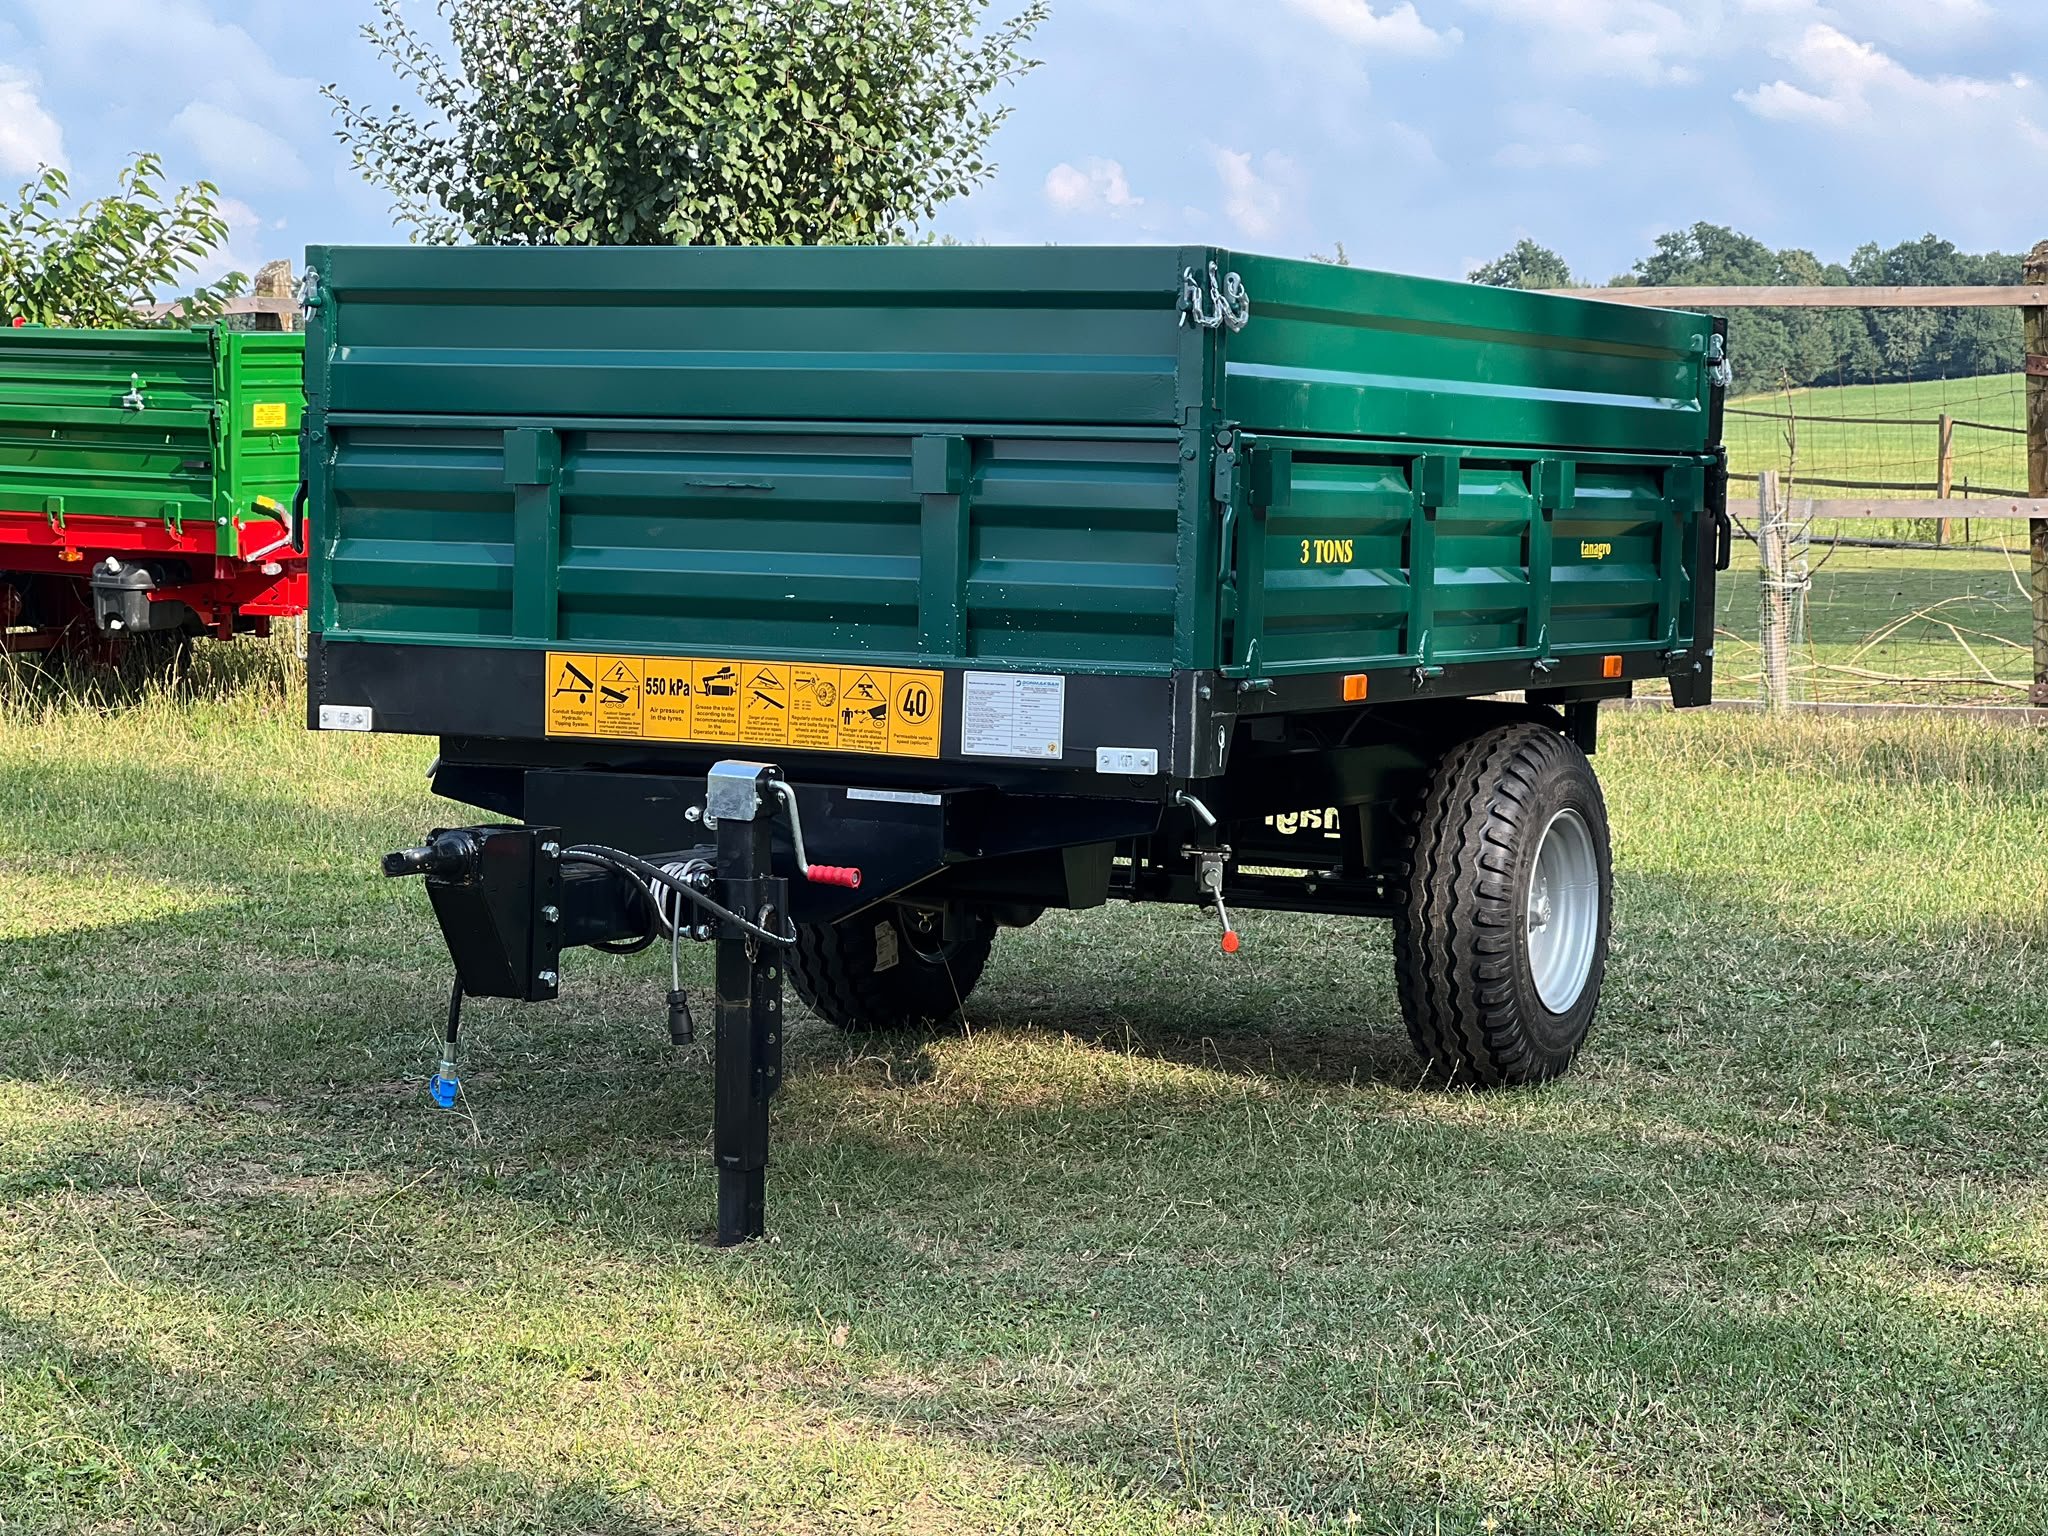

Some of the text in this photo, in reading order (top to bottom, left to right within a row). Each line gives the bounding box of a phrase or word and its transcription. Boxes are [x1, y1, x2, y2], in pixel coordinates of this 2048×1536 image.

[1300, 540, 1352, 563] 3 TONS
[1580, 540, 1611, 560] tanagro
[646, 677, 690, 696] 550 kPa
[903, 688, 927, 717] 40
